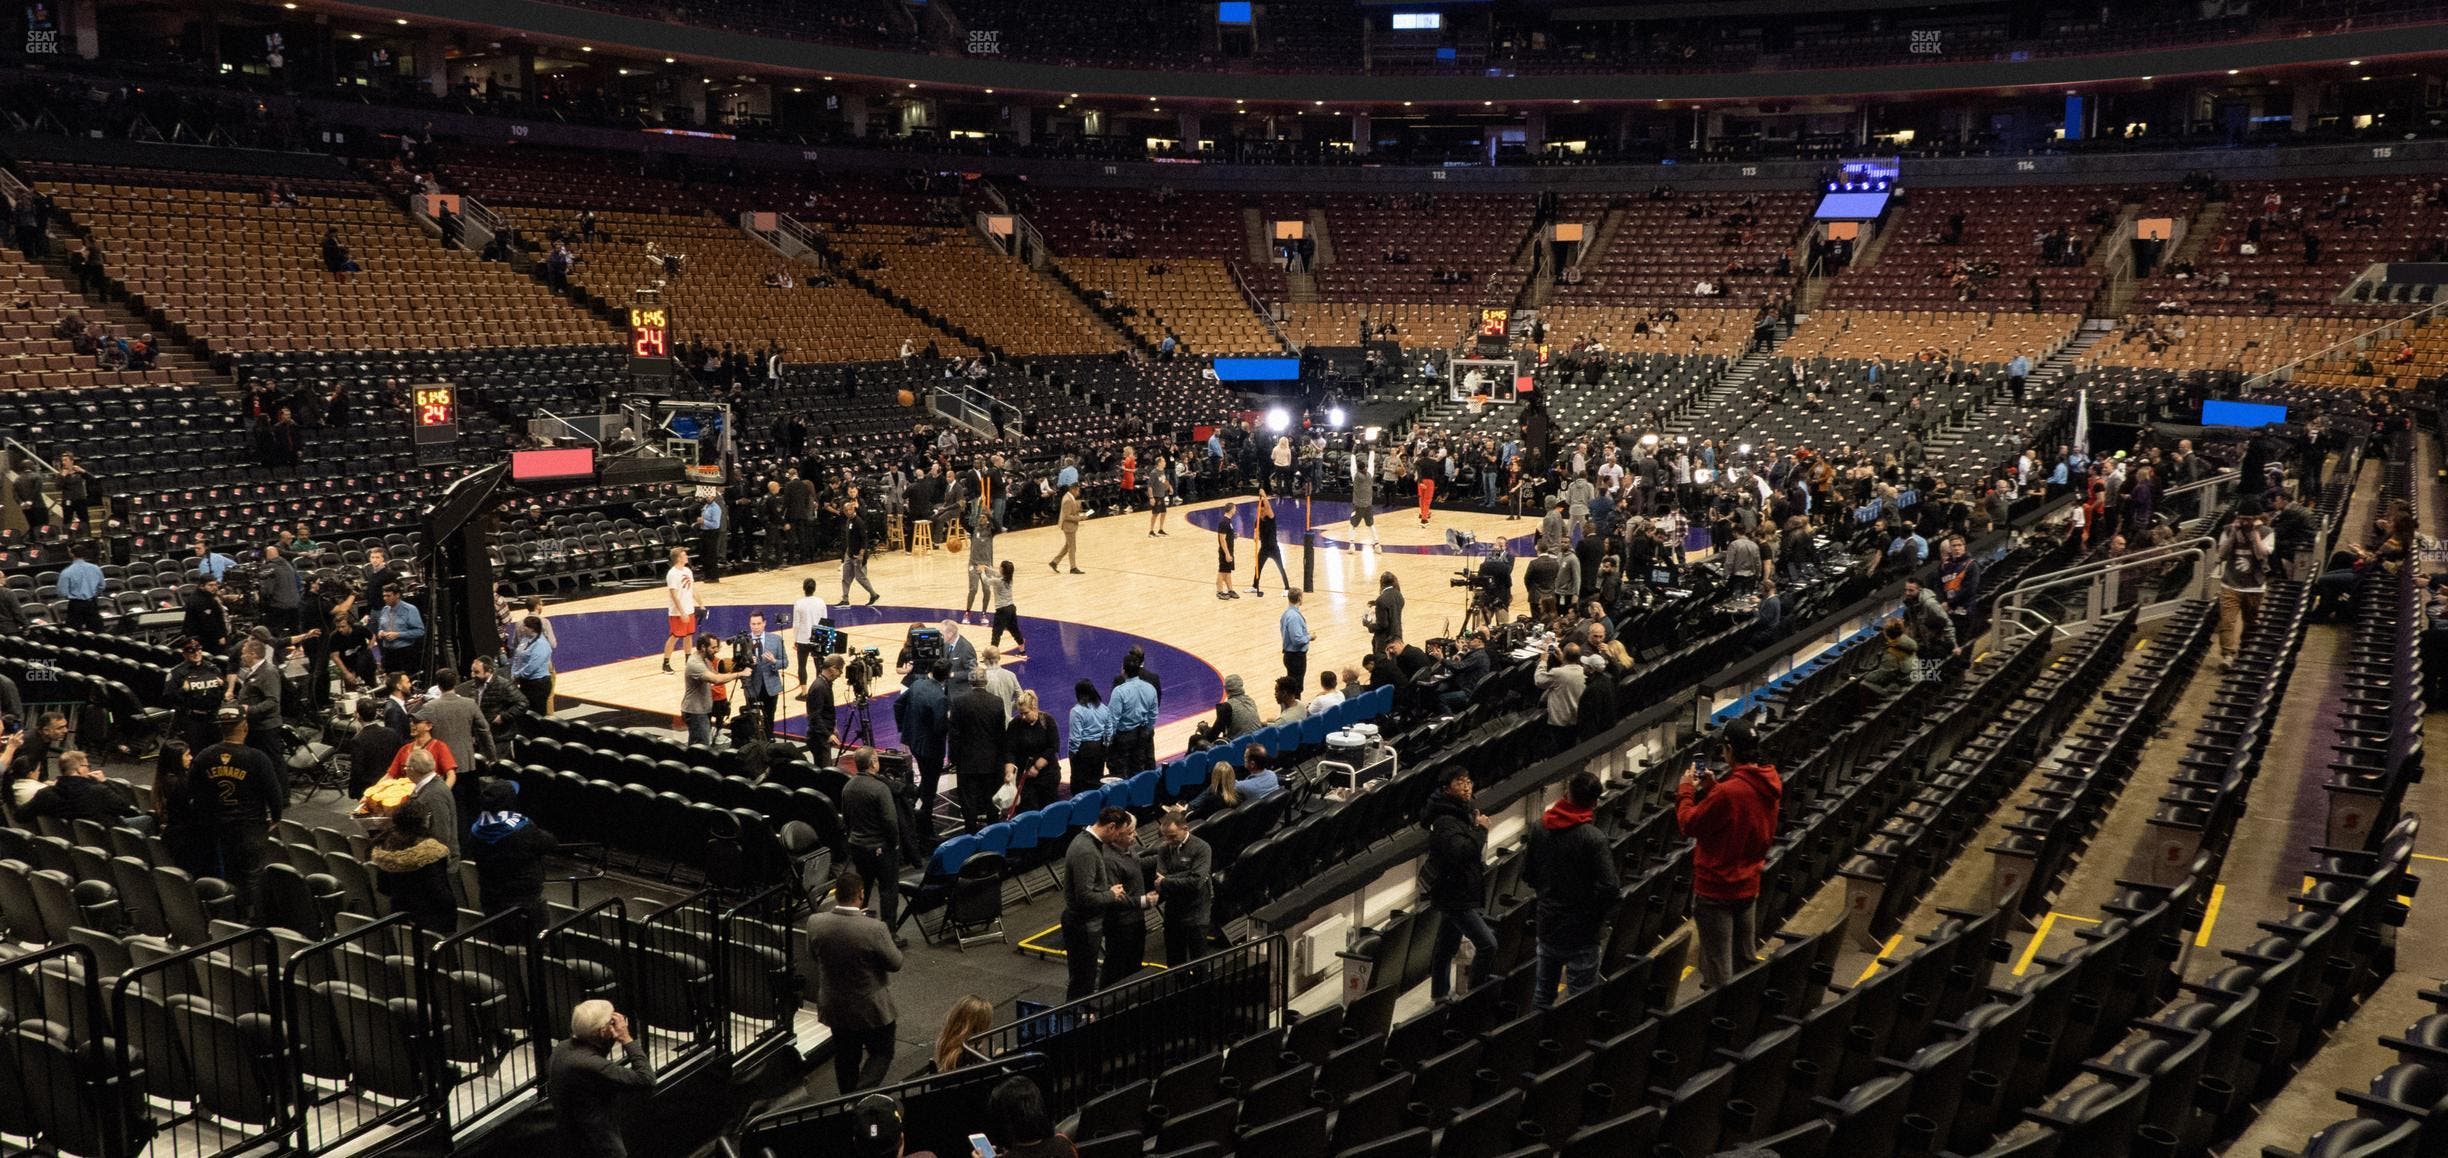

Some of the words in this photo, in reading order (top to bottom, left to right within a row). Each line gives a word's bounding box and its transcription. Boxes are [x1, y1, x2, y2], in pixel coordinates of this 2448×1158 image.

[511, 125, 529, 136] 109
[803, 151, 817, 160] 110
[2372, 147, 2393, 158] 115
[1104, 166, 1117, 175] 111
[1742, 167, 1757, 176] 113
[2017, 161, 2035, 171] 114
[1432, 171, 1446, 180] 112
[1484, 319, 1504, 335] 24
[637, 328, 663, 355] 24
[424, 405, 445, 423] 24
[190, 679, 219, 690] POLICE
[207, 766, 247, 781] LEONARD
[216, 780, 239, 805] 2
